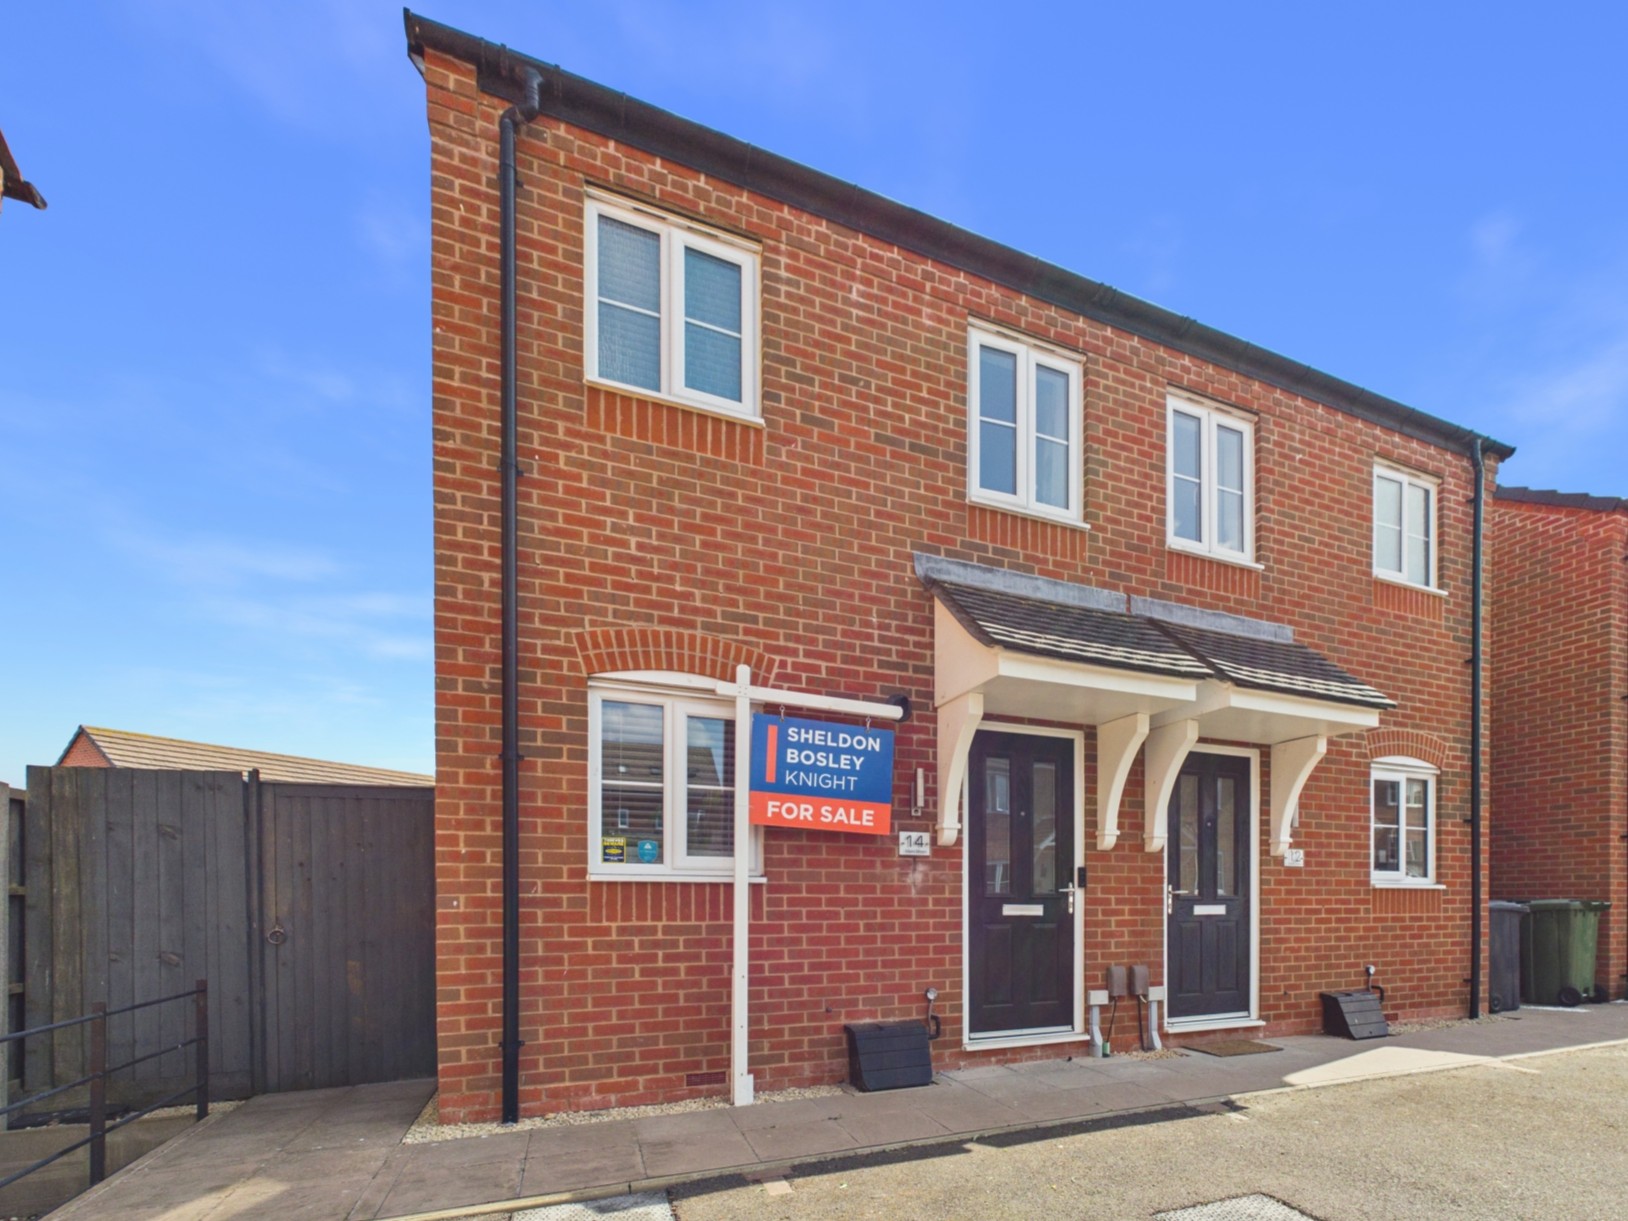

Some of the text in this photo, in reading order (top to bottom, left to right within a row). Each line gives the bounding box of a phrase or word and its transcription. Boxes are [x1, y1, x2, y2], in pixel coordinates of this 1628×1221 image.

[787, 727, 880, 752] SHELDON
[786, 748, 864, 770] BOSLEY
[785, 770, 858, 791] KNIGHT
[767, 801, 874, 826] FOR SALE
